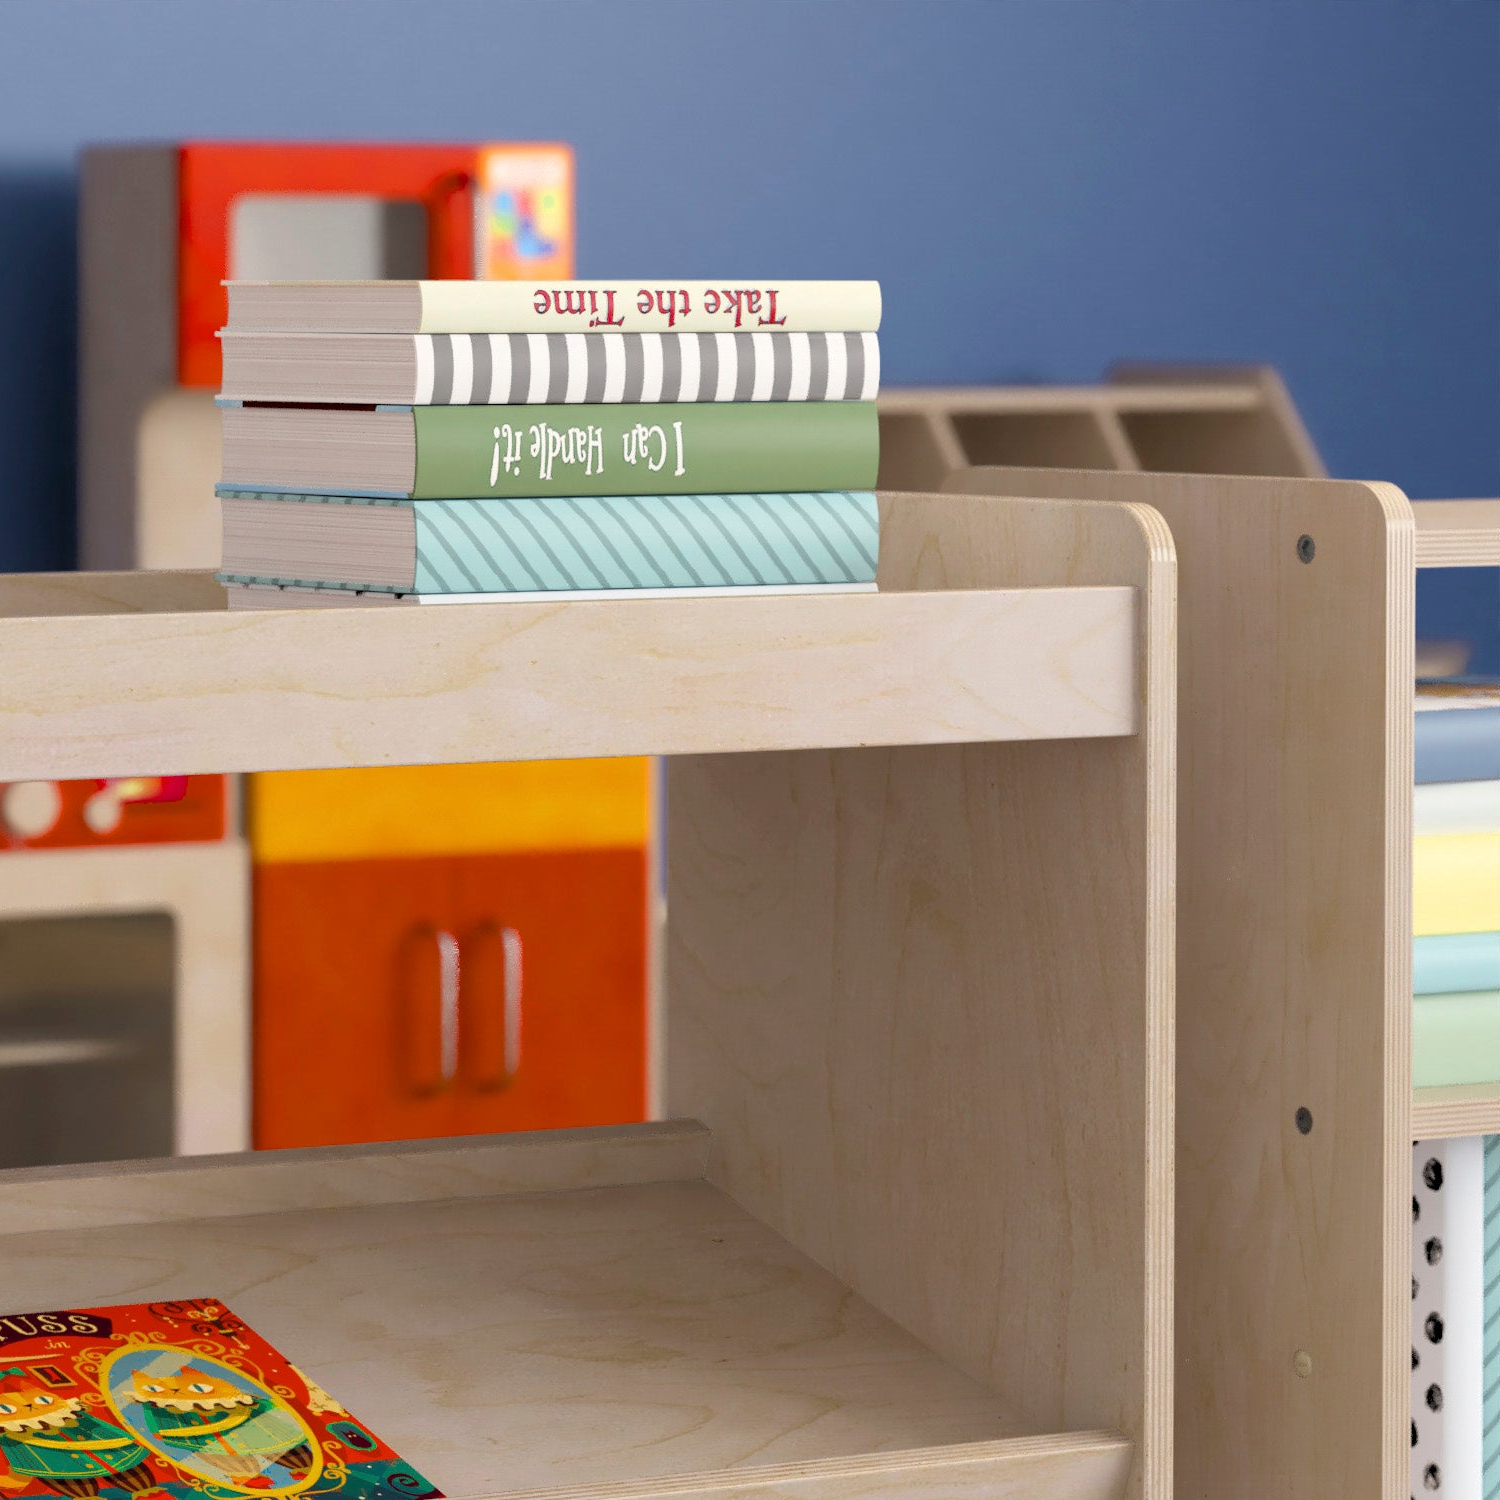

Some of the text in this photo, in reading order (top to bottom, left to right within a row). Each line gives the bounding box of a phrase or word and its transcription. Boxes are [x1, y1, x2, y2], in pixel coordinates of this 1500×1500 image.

[533, 289, 787, 328] Take the Time
[490, 421, 686, 487] I Can Handle it!
[44, 1340, 71, 1350] in
